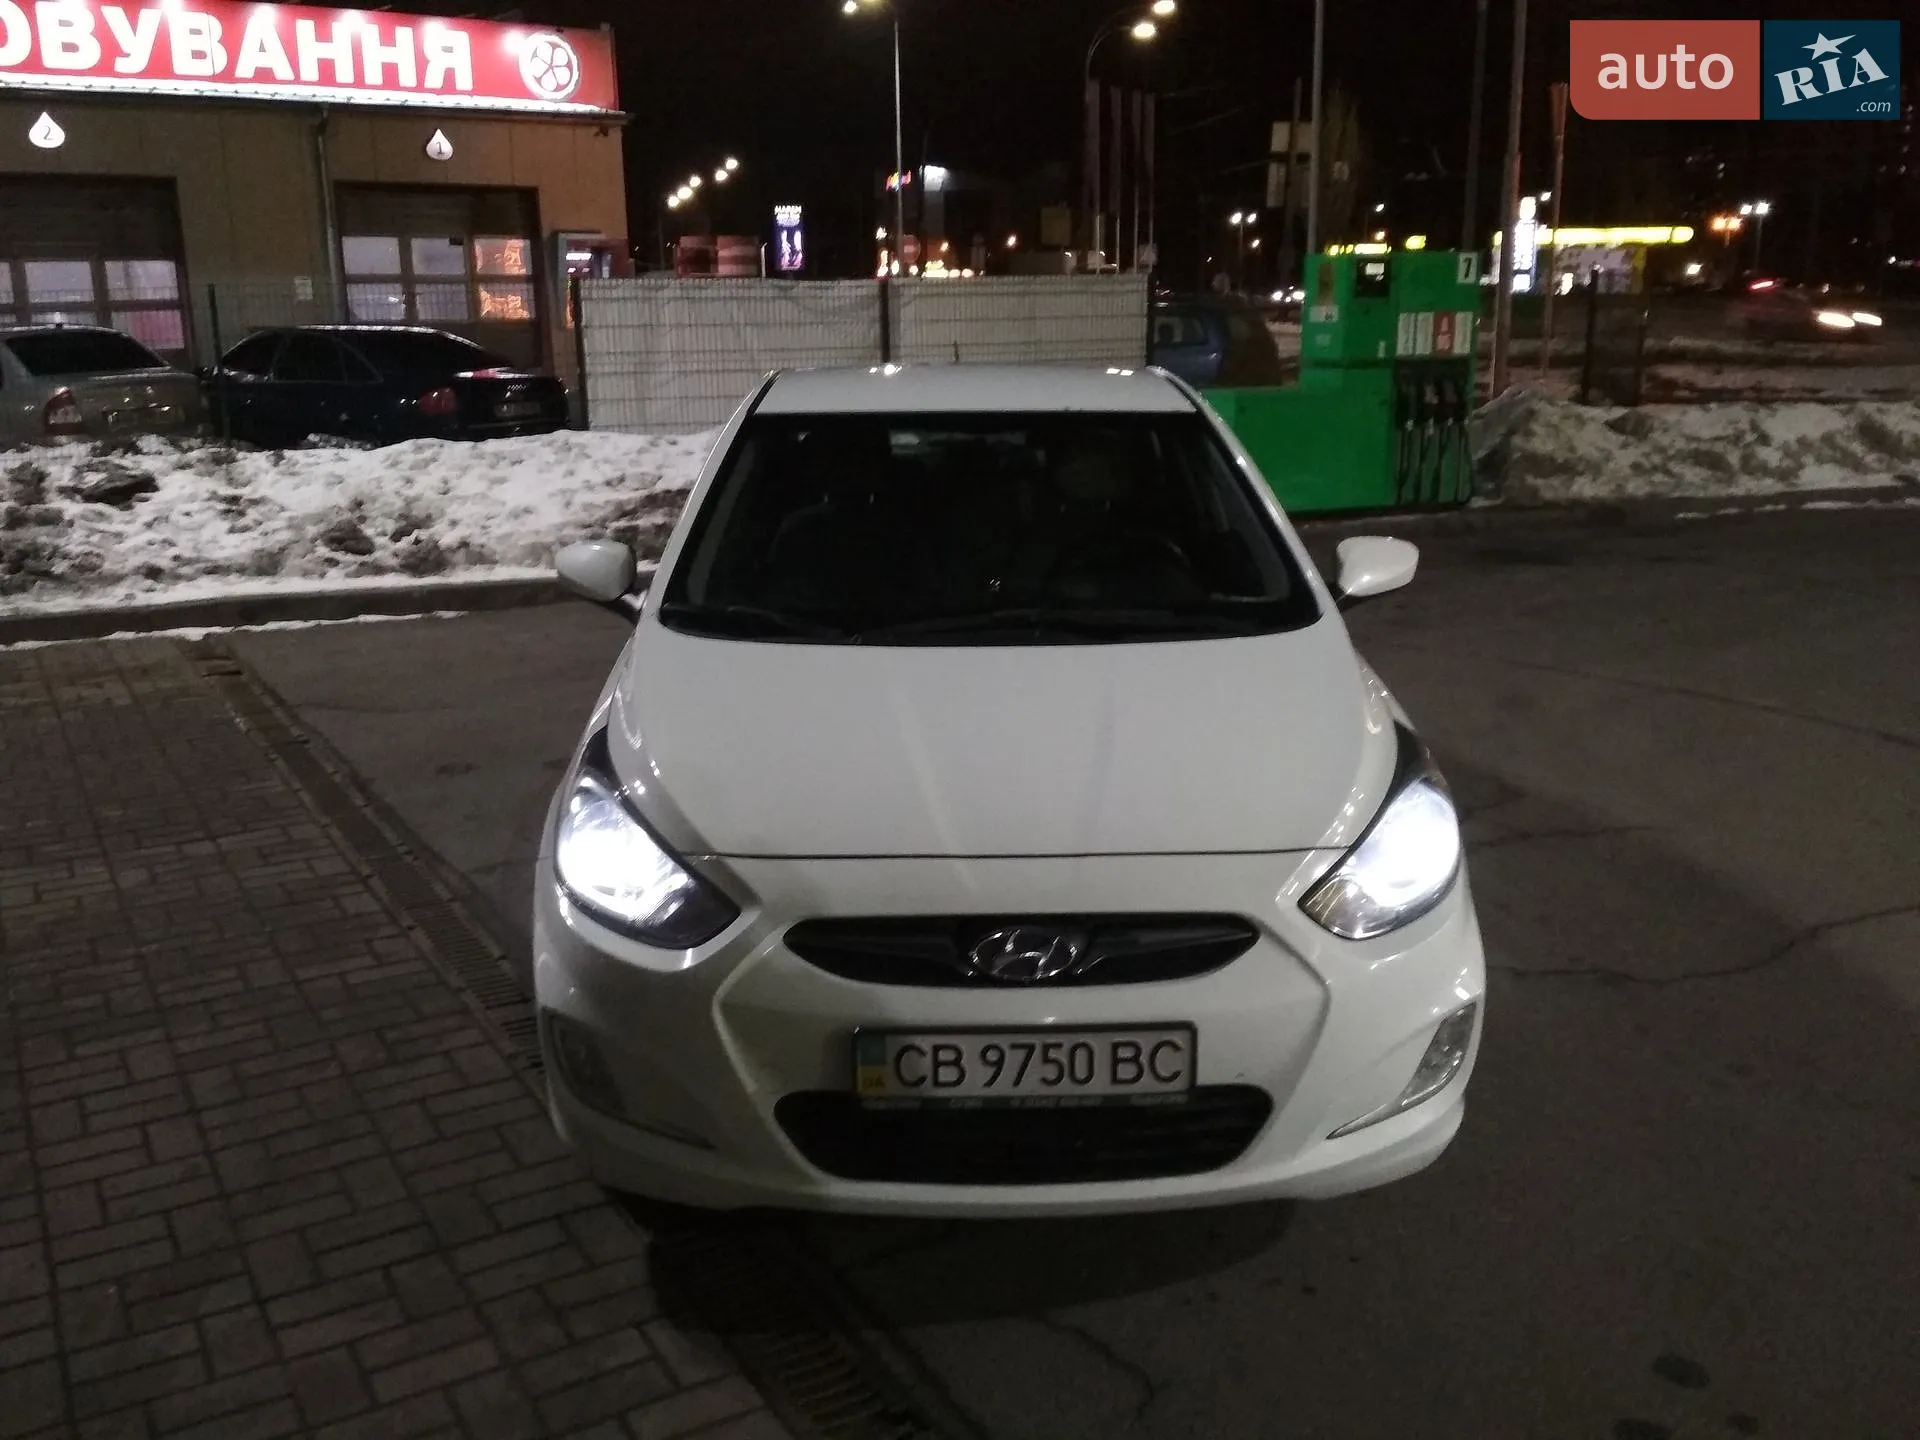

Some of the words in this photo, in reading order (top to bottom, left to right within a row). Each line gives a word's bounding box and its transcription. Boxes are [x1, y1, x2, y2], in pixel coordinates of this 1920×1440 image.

[43, 125, 54, 141] 2
[435, 141, 446, 155] 1
[894, 1043, 967, 1088] CB
[979, 1042, 1095, 1088] 9750
[1110, 1039, 1183, 1085] BC
